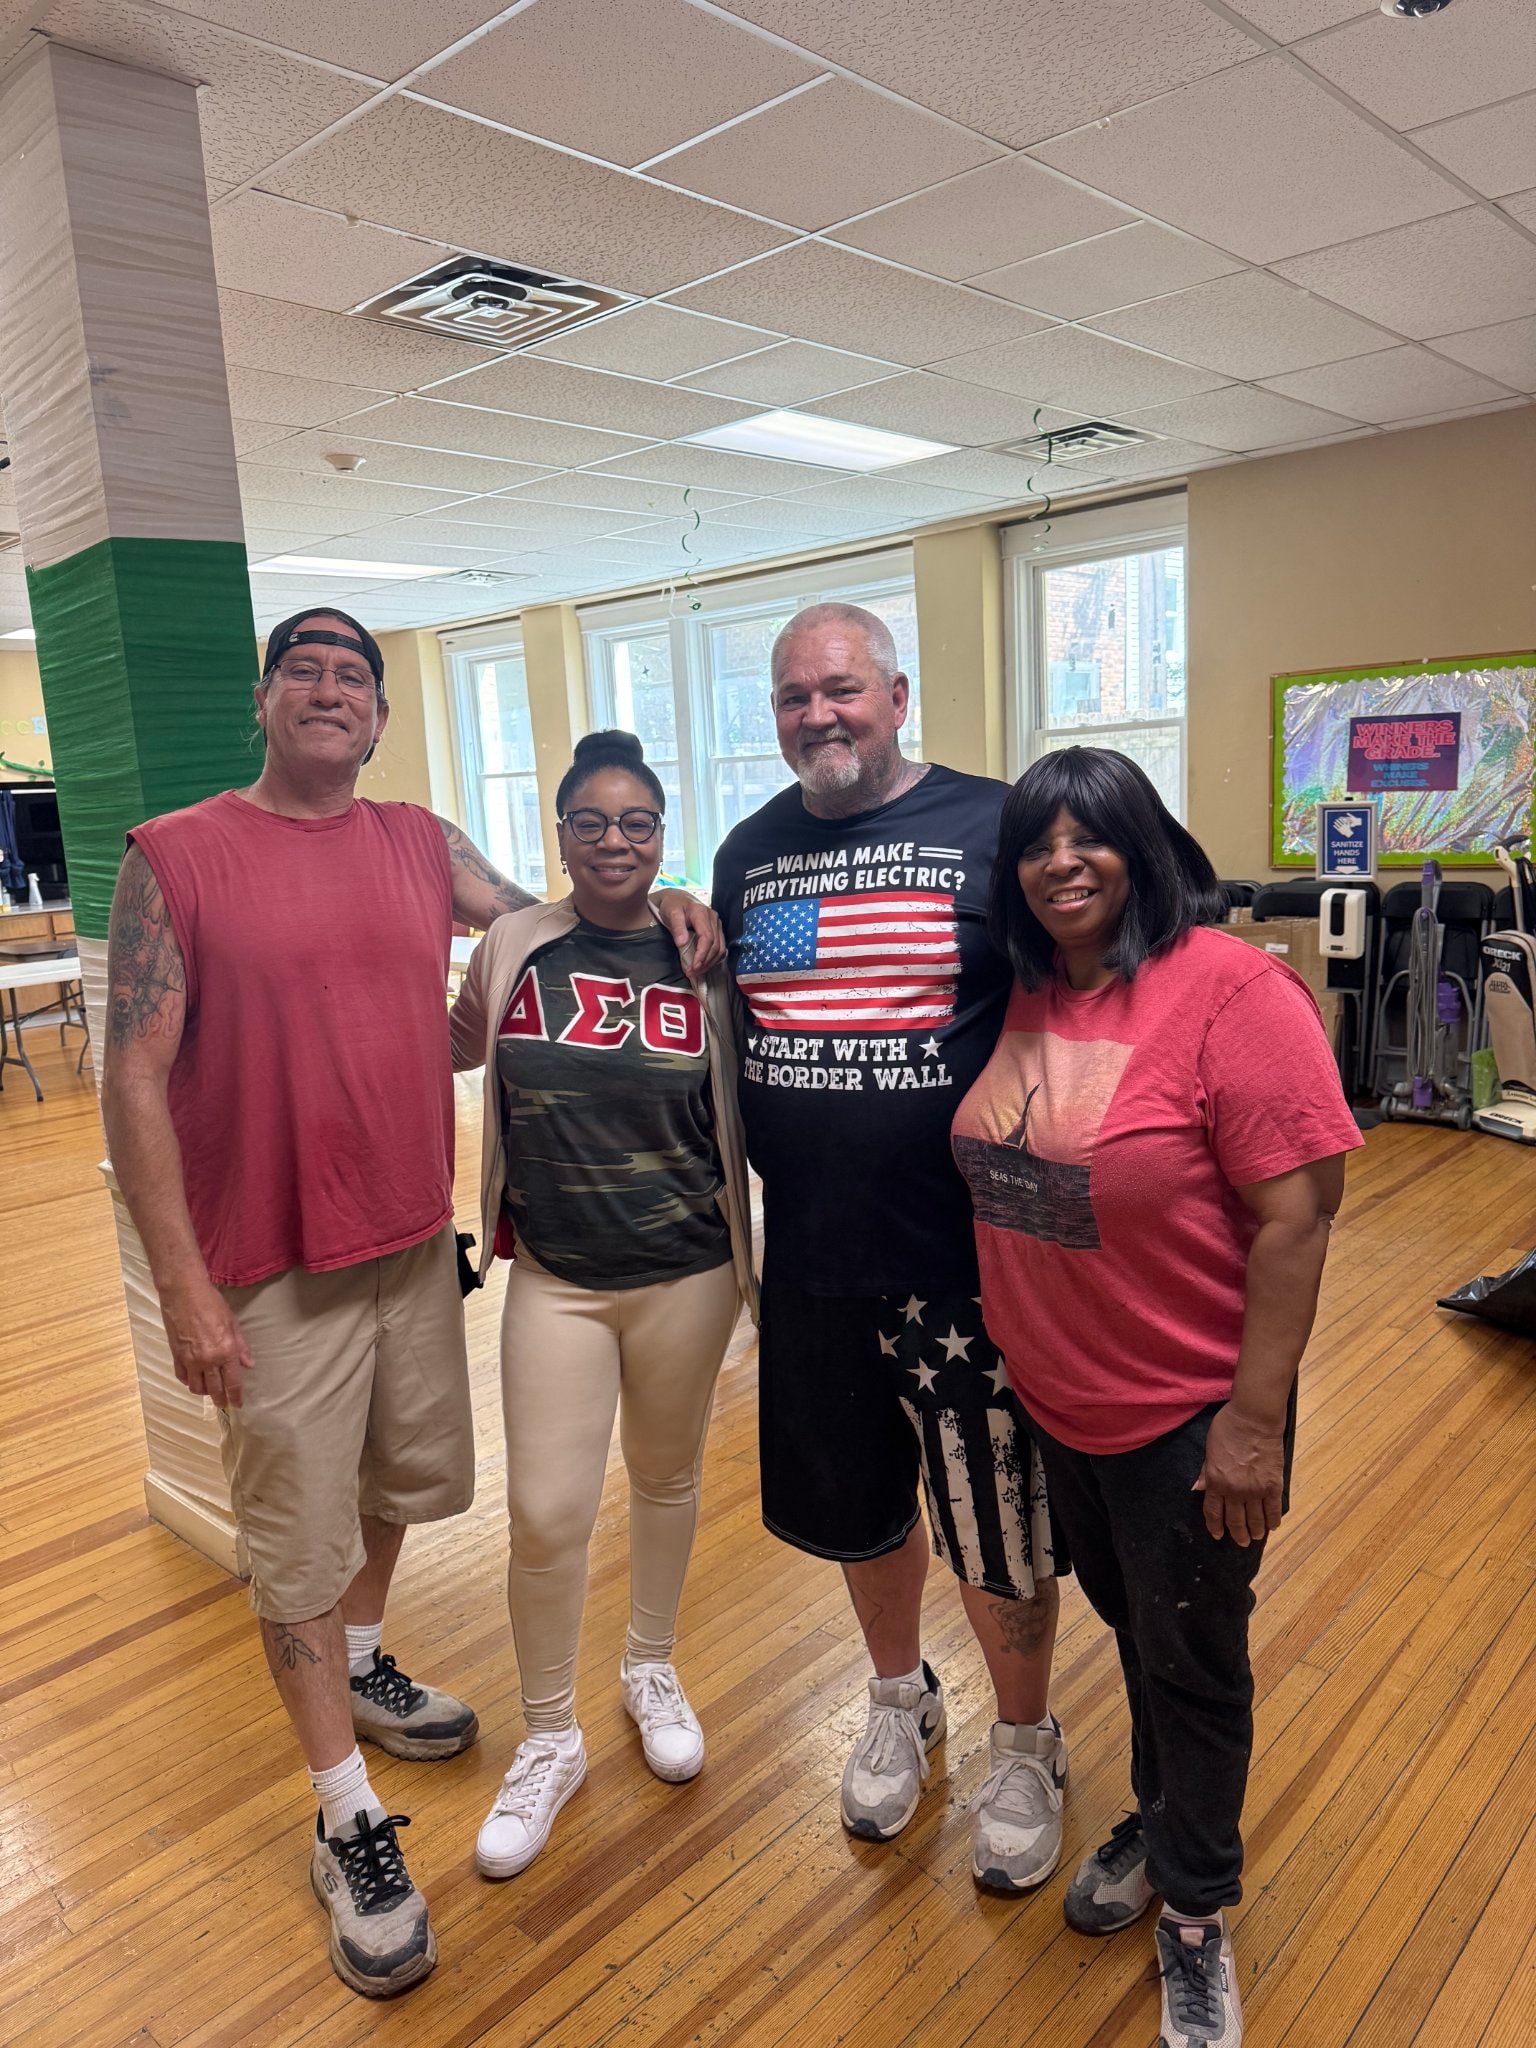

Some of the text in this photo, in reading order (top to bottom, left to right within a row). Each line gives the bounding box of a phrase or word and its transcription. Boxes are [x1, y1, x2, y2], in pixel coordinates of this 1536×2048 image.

[1353, 732, 1456, 748] MAKE THE
[1356, 720, 1454, 736] WINNERS
[1364, 745, 1441, 760] GRADE.
[777, 842, 915, 874] WANNA MAKE
[743, 865, 966, 909] EVERYTHING ELECTRIC?
[1483, 945, 1522, 961] ORECK
[759, 1036, 908, 1062] START WITH
[744, 1056, 953, 1091] THE BORDER WALL
[990, 1169, 1039, 1193] SEAS THE DAY
